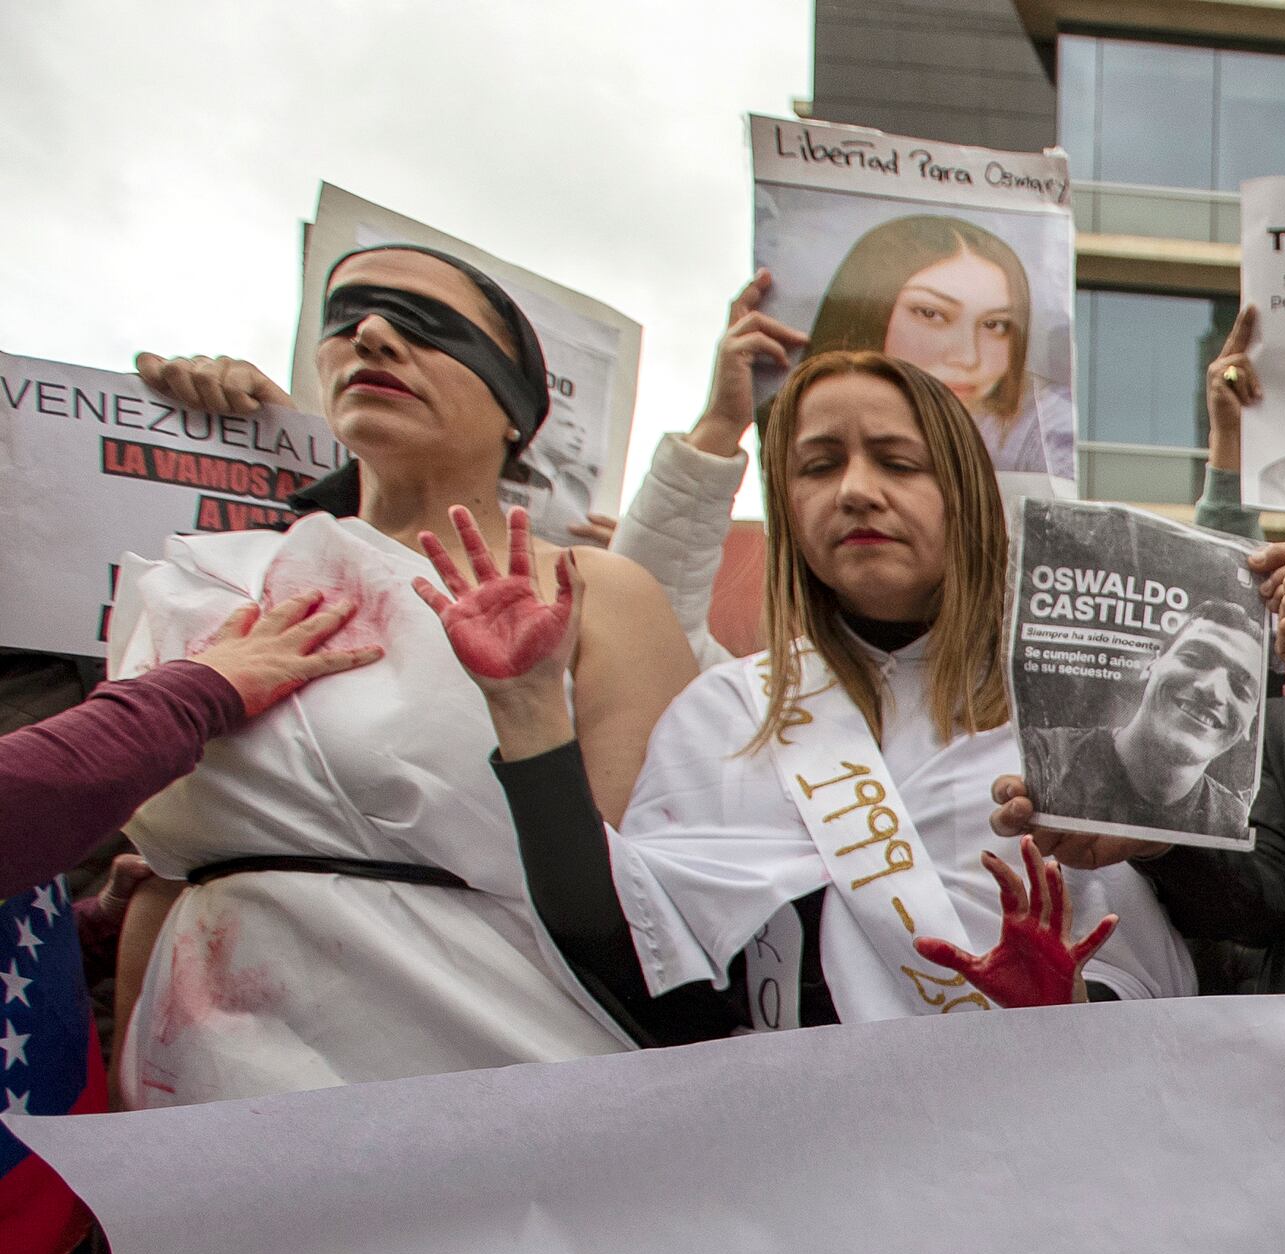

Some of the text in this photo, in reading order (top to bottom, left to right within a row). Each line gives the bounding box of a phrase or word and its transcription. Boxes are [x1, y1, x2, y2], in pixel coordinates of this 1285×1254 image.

[774, 126, 900, 176] Libertad
[909, 149, 973, 185] Para
[0, 374, 302, 463] VENEZUELA
[104, 440, 148, 476] LA
[152, 450, 272, 500] VAMOS
[1031, 564, 1190, 612] OSWALDO
[1029, 591, 1186, 636] CASTILLO
[1024, 645, 1142, 670] Se cumplen 6 años
[1026, 626, 1162, 651] Siempre ha sido inocente
[1023, 659, 1122, 682] de su secuestro
[795, 760, 915, 891] 1999
